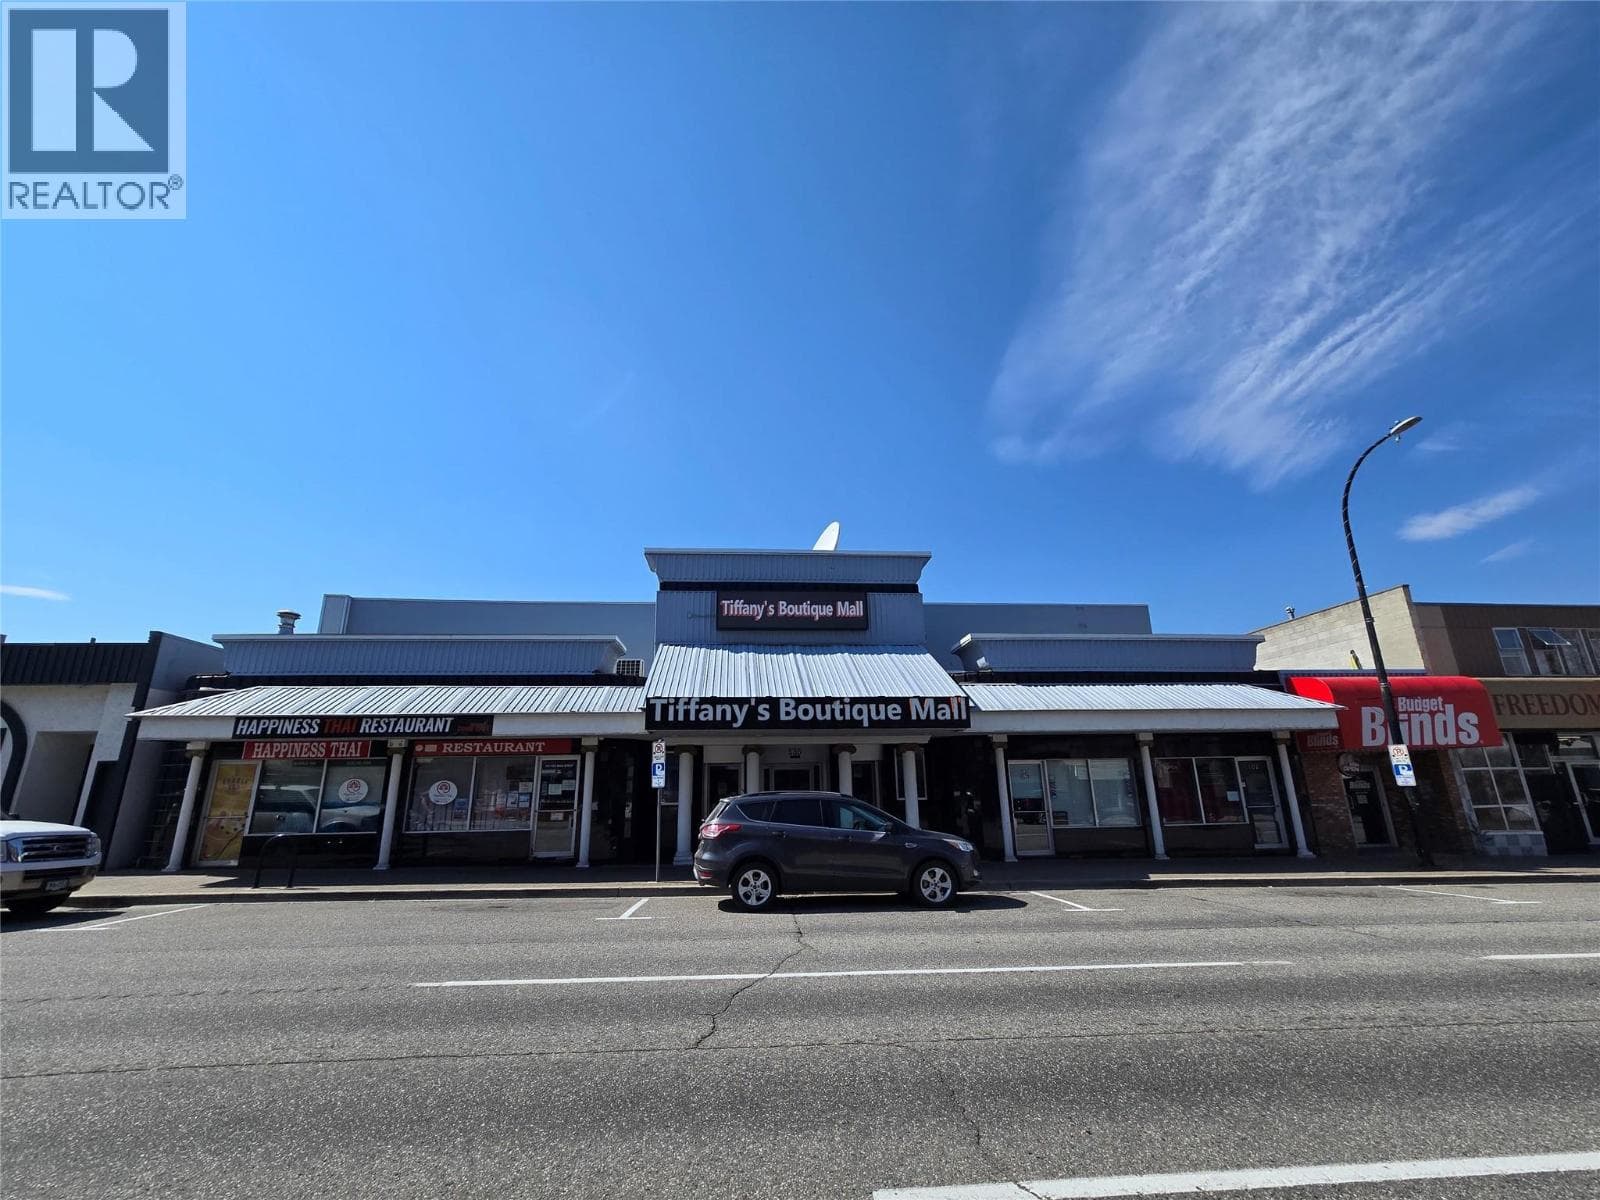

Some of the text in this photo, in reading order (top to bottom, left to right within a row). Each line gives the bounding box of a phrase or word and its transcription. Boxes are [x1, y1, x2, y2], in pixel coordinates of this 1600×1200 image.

[720, 599, 864, 621] Tiffany's Boutique Mall
[649, 697, 967, 728] Tiffany's Boutique Mall
[1397, 696, 1445, 713] Budget
[235, 718, 321, 735] HAPPINESS
[324, 718, 359, 734] THAI
[359, 717, 455, 733] RESTAURANT
[252, 741, 362, 759] HAPPINESS THAI
[442, 742, 546, 754] RESTAURANT
